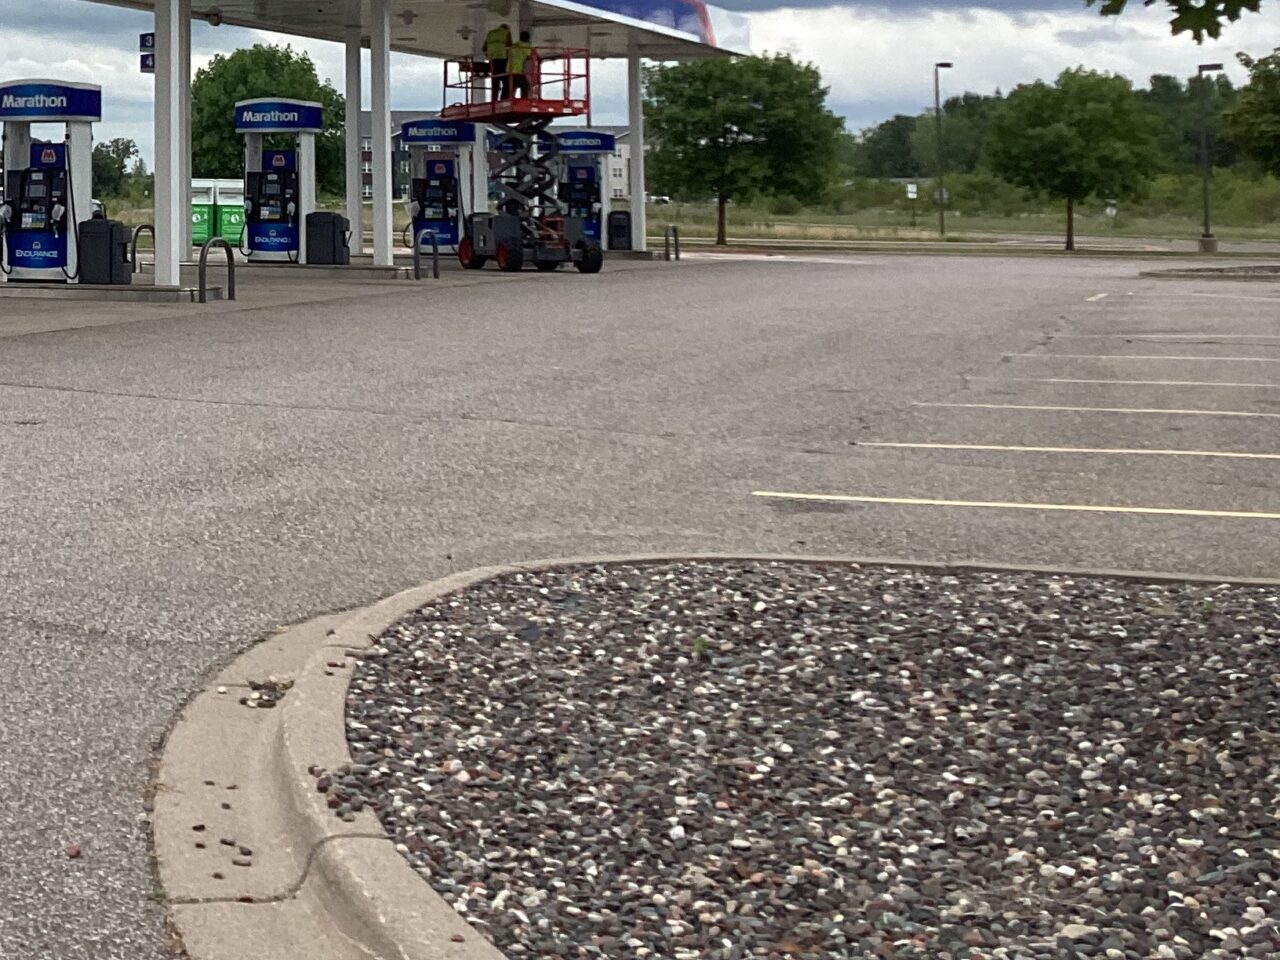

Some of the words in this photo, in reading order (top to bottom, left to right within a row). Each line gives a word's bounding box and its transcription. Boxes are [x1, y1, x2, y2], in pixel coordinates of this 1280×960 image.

[145, 35, 153, 46] 3
[2, 95, 67, 108] Marathon
[242, 111, 298, 122] Marathon
[408, 127, 457, 136] Marathon
